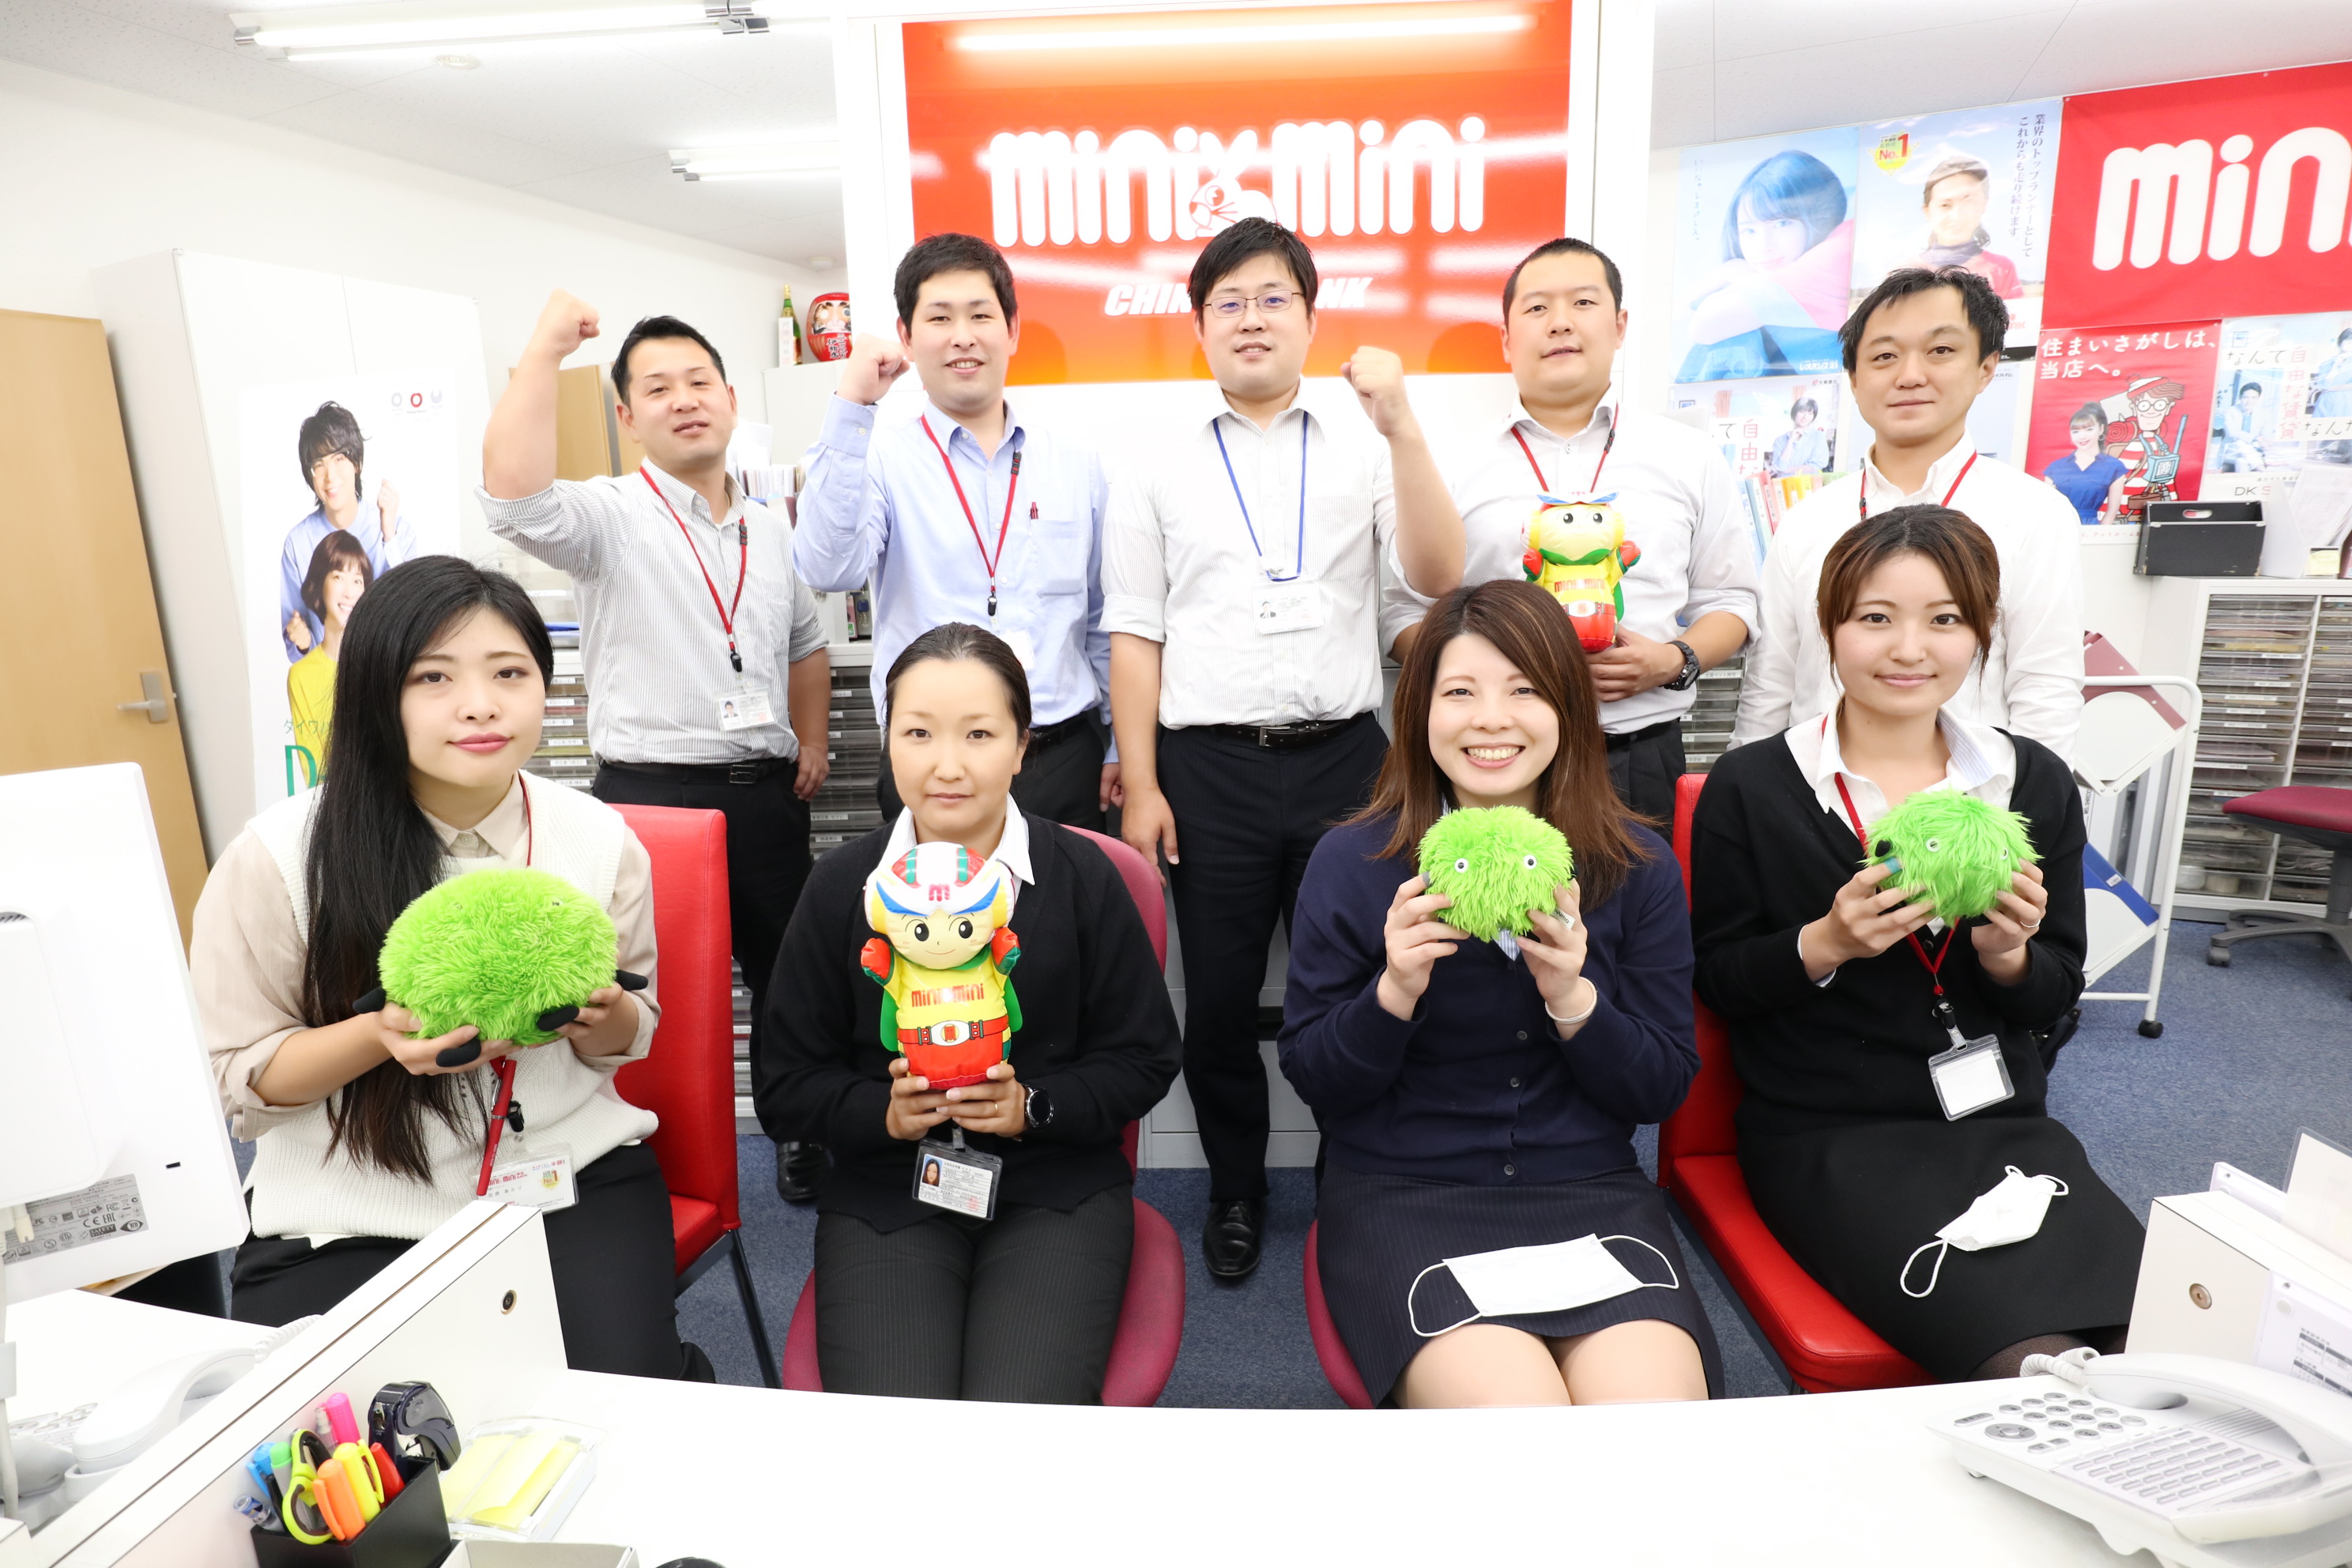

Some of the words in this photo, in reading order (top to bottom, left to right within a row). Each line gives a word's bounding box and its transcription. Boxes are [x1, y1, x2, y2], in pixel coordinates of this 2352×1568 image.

[2008, 116, 2030, 243] これからも走り続けます。
[2022, 114, 2046, 258] 業界のトップランナーとして
[2092, 126, 2352, 270] min
[1104, 283, 1193, 317] CHIN
[1312, 277, 1372, 311] NK
[2040, 330, 2216, 357] 住まいさがしは、
[2226, 349, 2288, 367] なんて
[2040, 358, 2122, 379] 当店へ。
[2278, 345, 2308, 439] 自由な賃貸
[2233, 486, 2257, 496] DK
